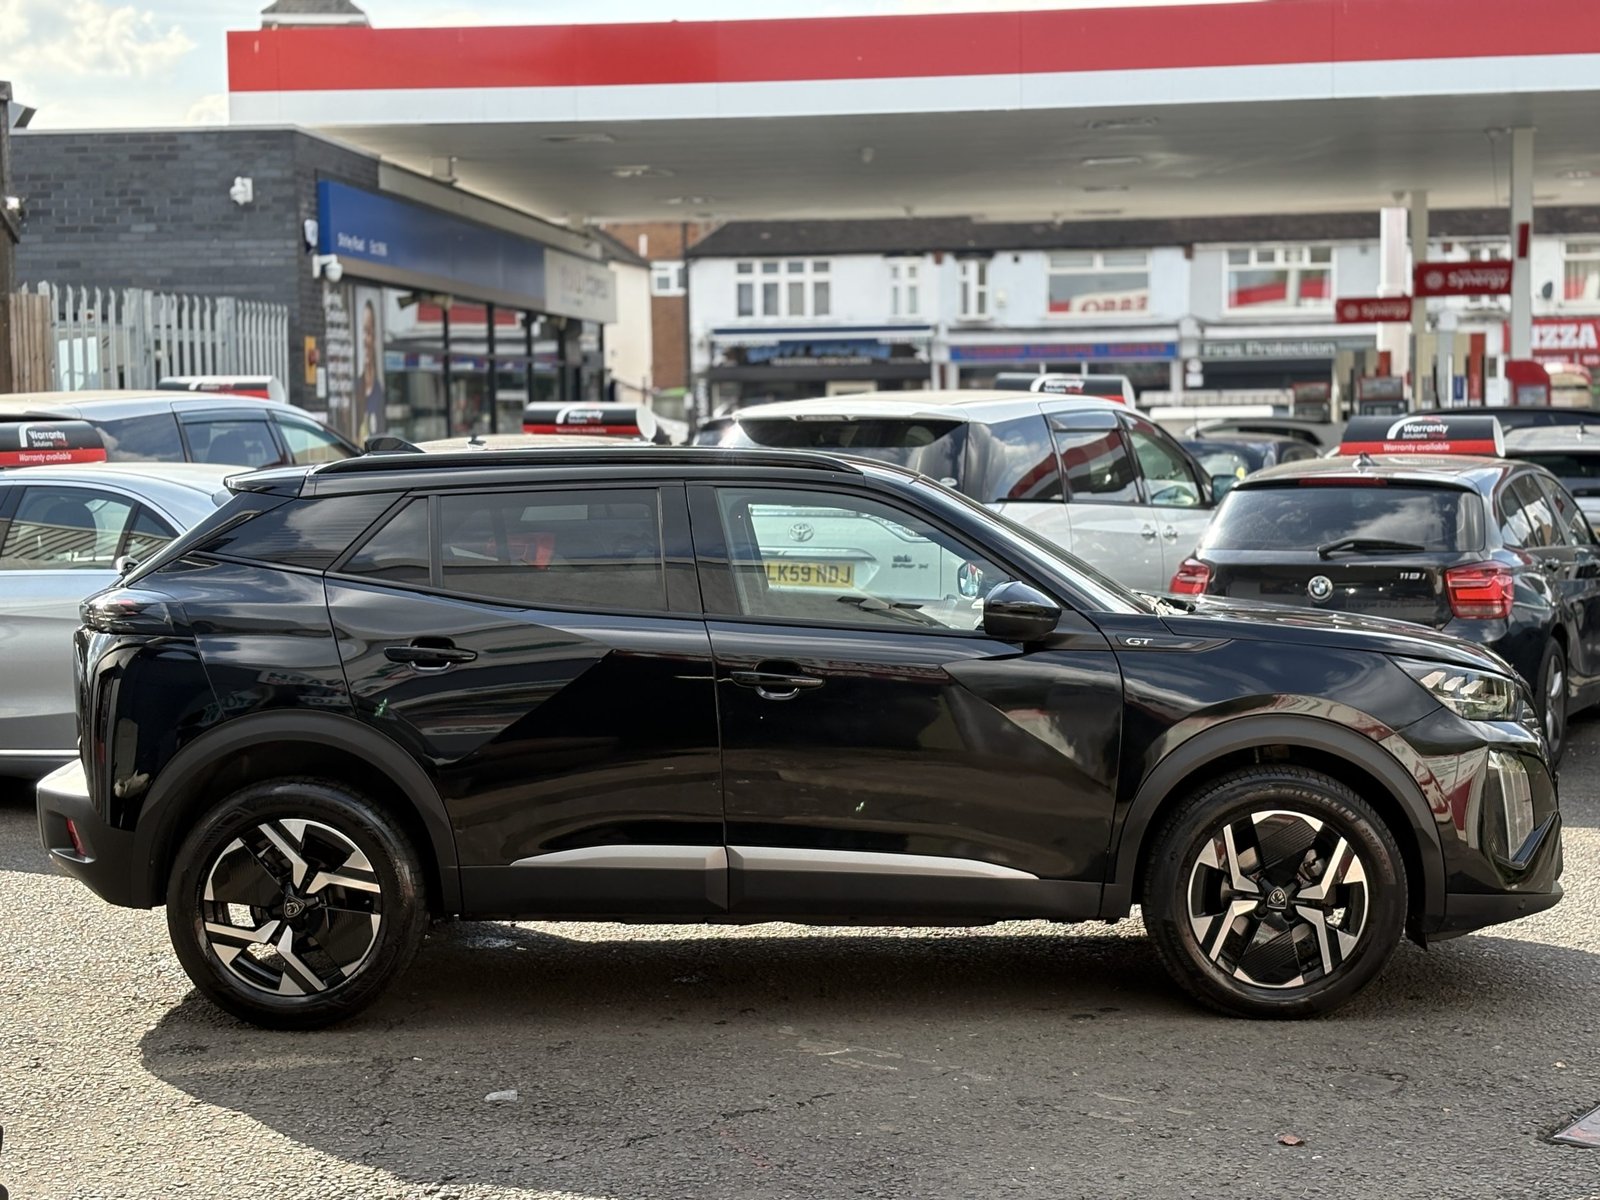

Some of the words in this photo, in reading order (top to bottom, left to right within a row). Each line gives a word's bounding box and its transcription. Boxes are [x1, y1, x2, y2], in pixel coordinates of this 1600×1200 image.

[1447, 271, 1507, 290] Synergy
[1361, 303, 1409, 319] Synergy
[1532, 323, 1598, 349] IZZA
[1204, 344, 1242, 357] First
[1246, 342, 1336, 356] Protection
[28, 430, 66, 441] Warranty
[1403, 424, 1449, 434] Warranty
[1383, 443, 1416, 452] Warranty
[1416, 442, 1450, 451] available
[19, 453, 46, 463] Warranty
[46, 451, 72, 461] available
[767, 563, 811, 582] LK59
[816, 565, 851, 584] NDJ
[1126, 637, 1154, 646] GT
[1279, 787, 1358, 822] MICHELIN
